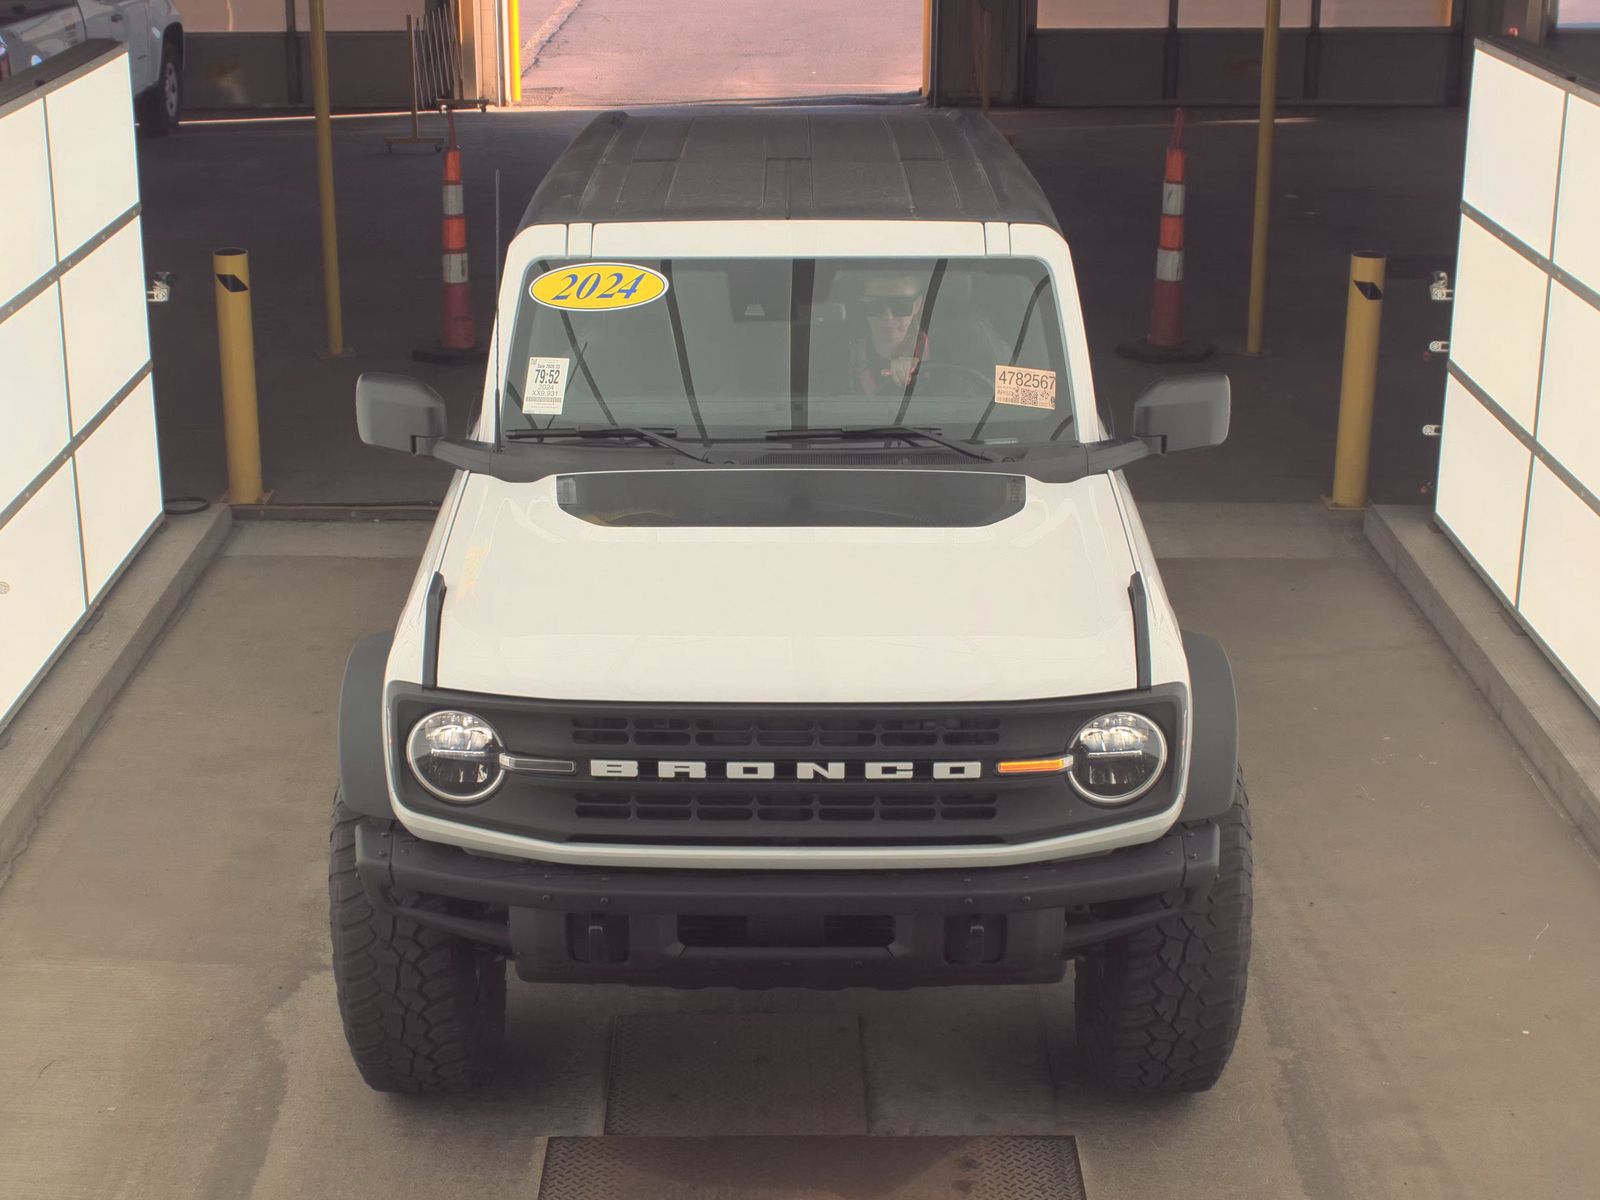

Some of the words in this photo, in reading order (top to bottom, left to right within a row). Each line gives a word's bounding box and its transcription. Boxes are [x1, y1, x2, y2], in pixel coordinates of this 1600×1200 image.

[550, 272, 647, 301] 2024
[534, 369, 560, 384] 79:52
[998, 370, 1056, 390] 4782567
[590, 759, 982, 780] BRONCO
